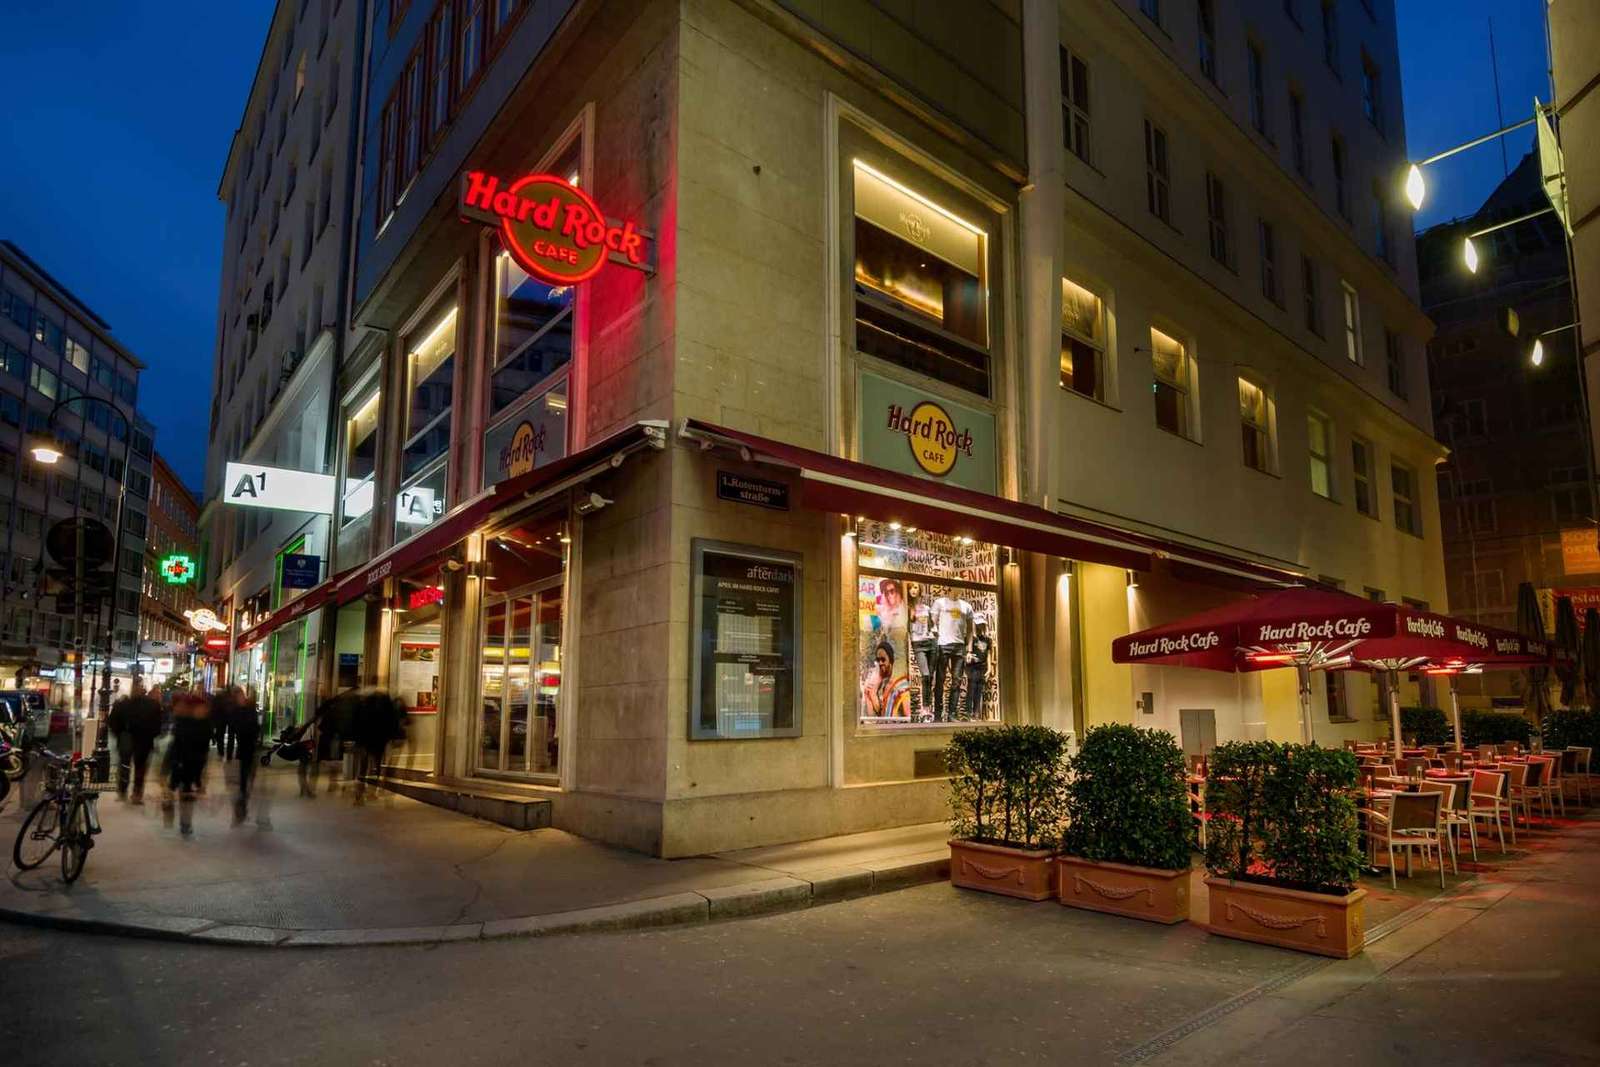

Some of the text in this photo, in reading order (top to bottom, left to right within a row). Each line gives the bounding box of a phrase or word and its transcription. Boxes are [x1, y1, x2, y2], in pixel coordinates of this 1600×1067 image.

[465, 171, 641, 263] Hard Rock
[533, 240, 578, 265] CAFE
[887, 403, 973, 456] Hard Rock
[498, 423, 546, 472] Hard Rock
[923, 449, 945, 464] CAFE
[231, 471, 266, 498] A1
[907, 549, 952, 567] BUDAPEST
[1260, 618, 1371, 641] Hard Rock Cafe
[1406, 616, 1445, 639] Hard Rock Cafe
[1129, 631, 1219, 656] Hard Rock Cafe
